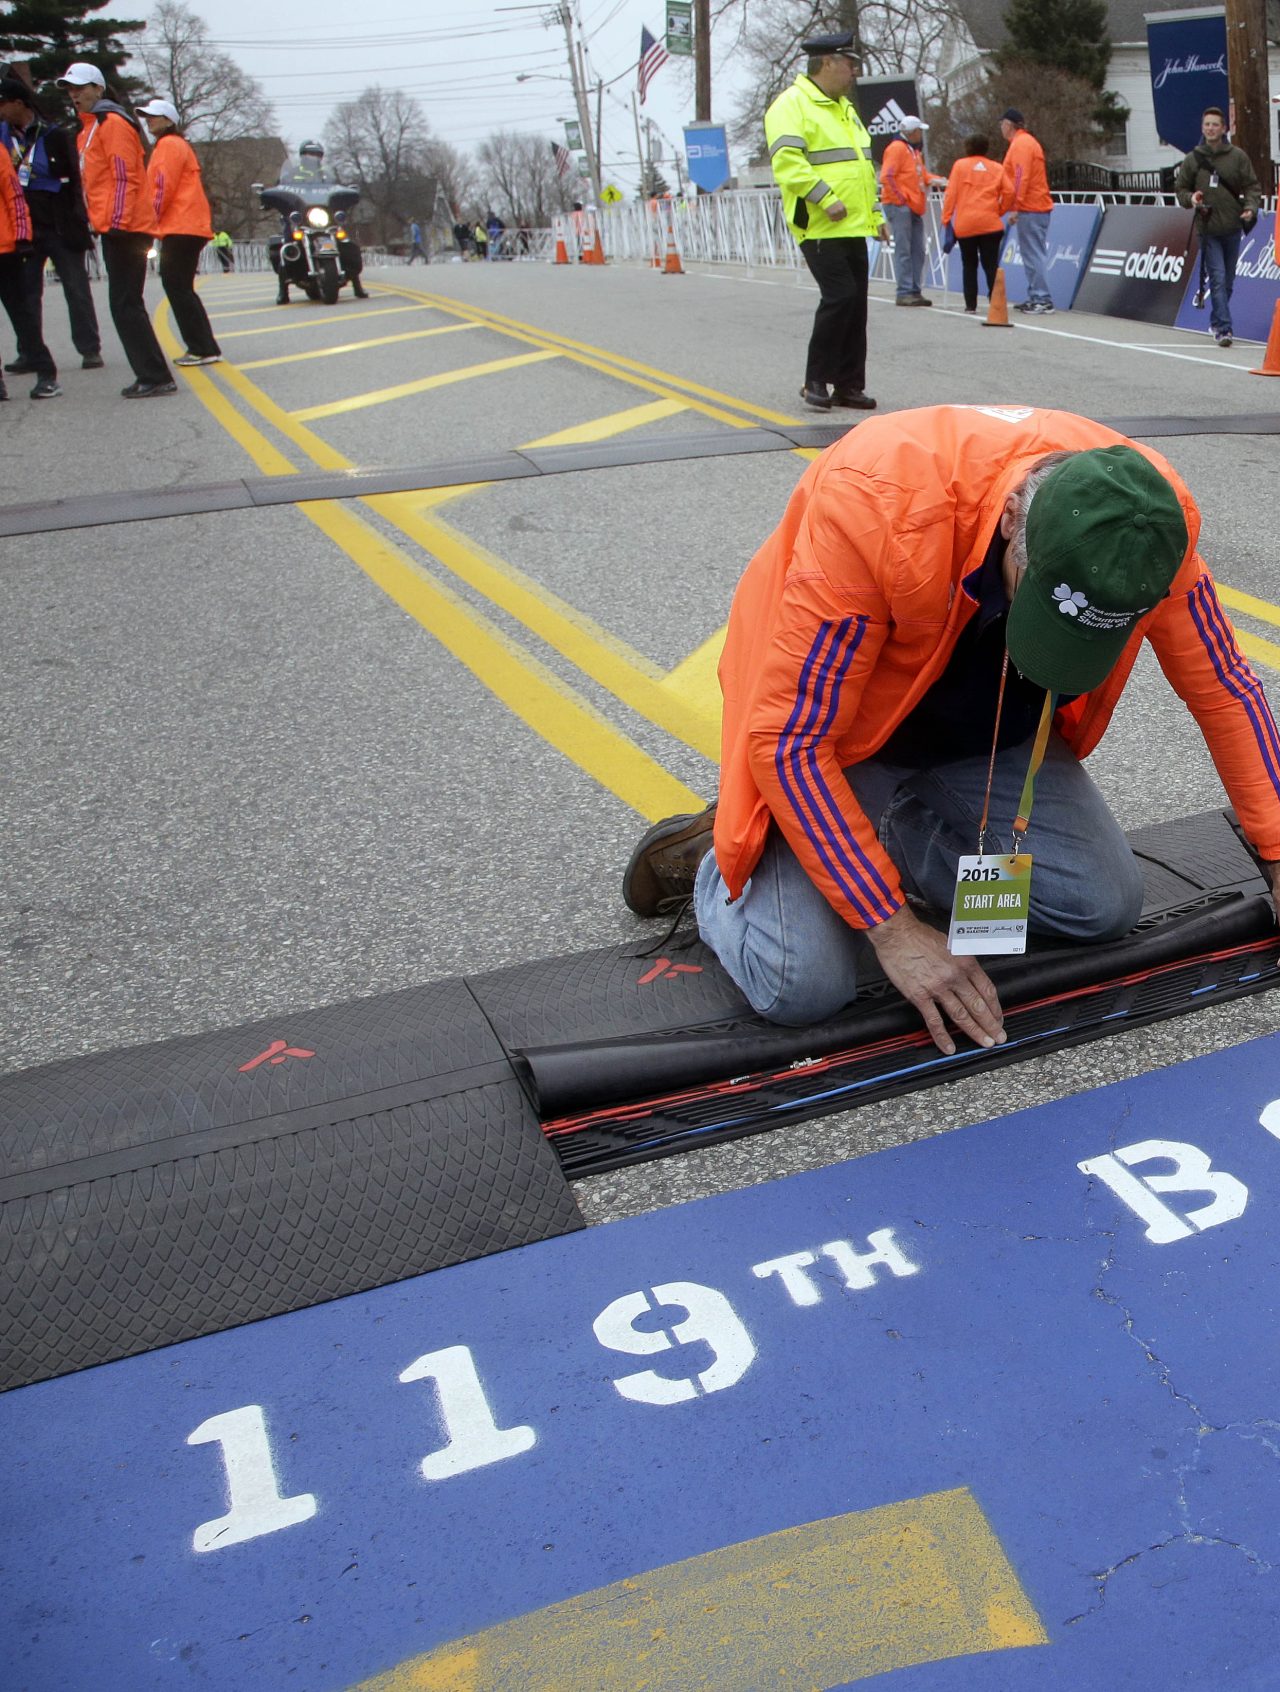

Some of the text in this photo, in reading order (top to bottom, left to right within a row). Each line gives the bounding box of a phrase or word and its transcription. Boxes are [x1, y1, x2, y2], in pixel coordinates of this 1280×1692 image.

[1154, 57, 1185, 89] John
[868, 121, 900, 136] adid
[1124, 245, 1185, 283] adidas
[1077, 615, 1114, 628] Shuffle
[1083, 610, 1131, 623] Shamrock
[961, 867, 1000, 882] 2015
[963, 893, 1022, 909] START AREA
